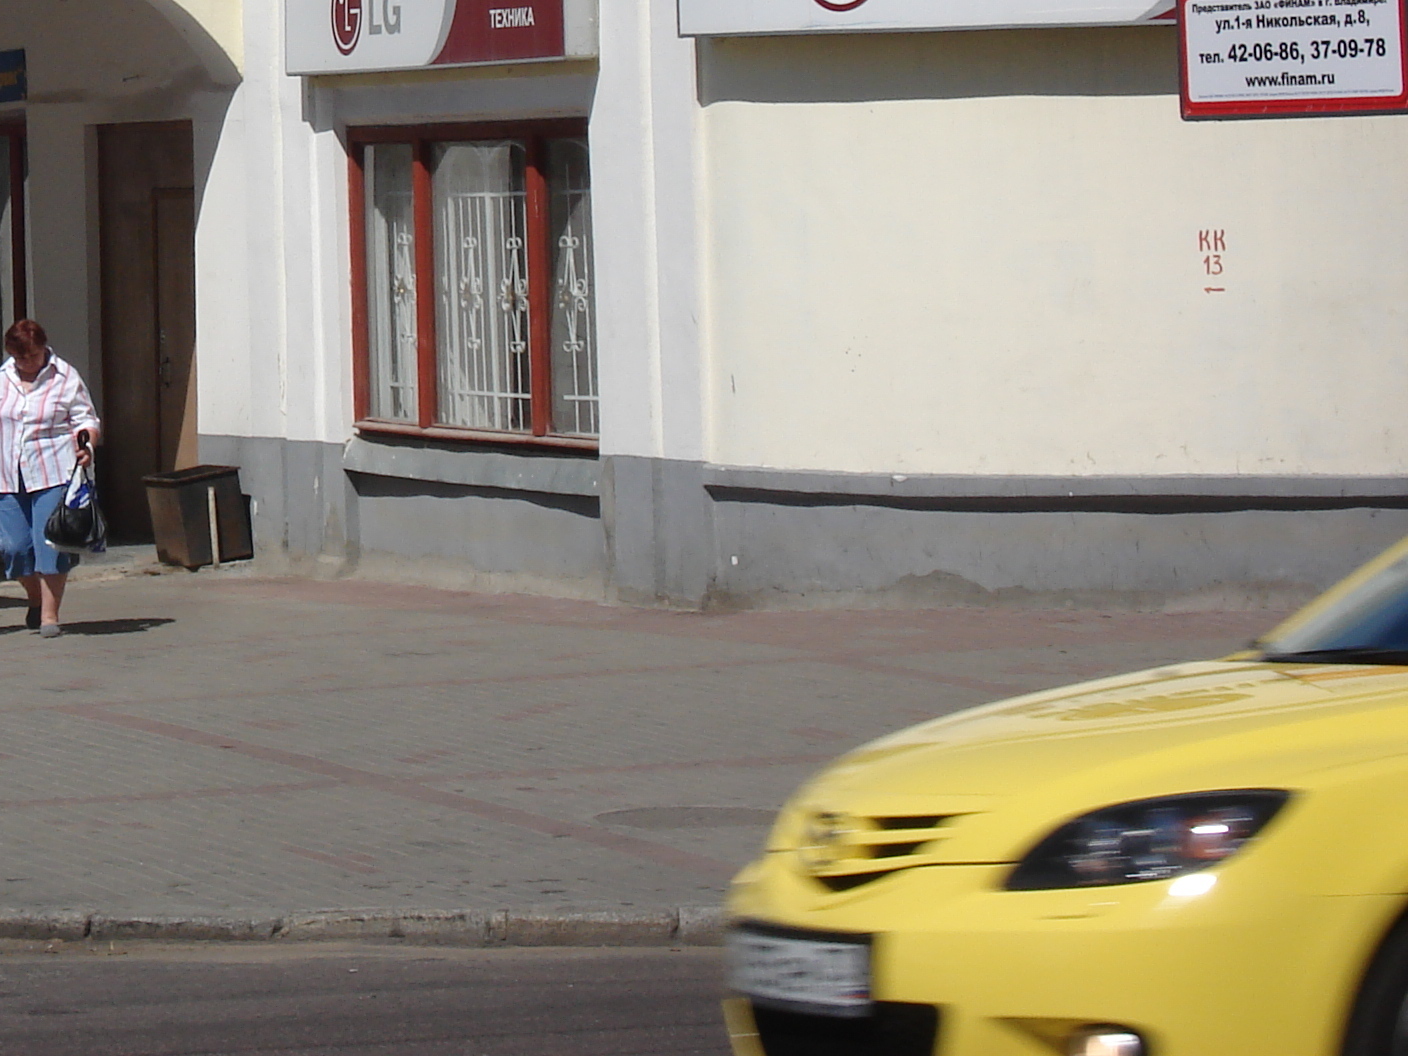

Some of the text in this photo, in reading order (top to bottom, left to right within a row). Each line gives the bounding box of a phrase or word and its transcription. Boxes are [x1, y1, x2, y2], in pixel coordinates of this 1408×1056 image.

[1192, 3, 1252, 15] Представитель
[1254, 0, 1271, 10] ЗАО
[489, 7, 535, 29] ТЕХНИКА
[1256, 13, 1340, 28] Никольская,
[1344, 9, 1370, 27] д.8,
[1199, 38, 1386, 64] тел. 42-06-86, 37-09-78
[1245, 72, 1335, 87] www.finam.ru
[1203, 254, 1224, 275] 13
